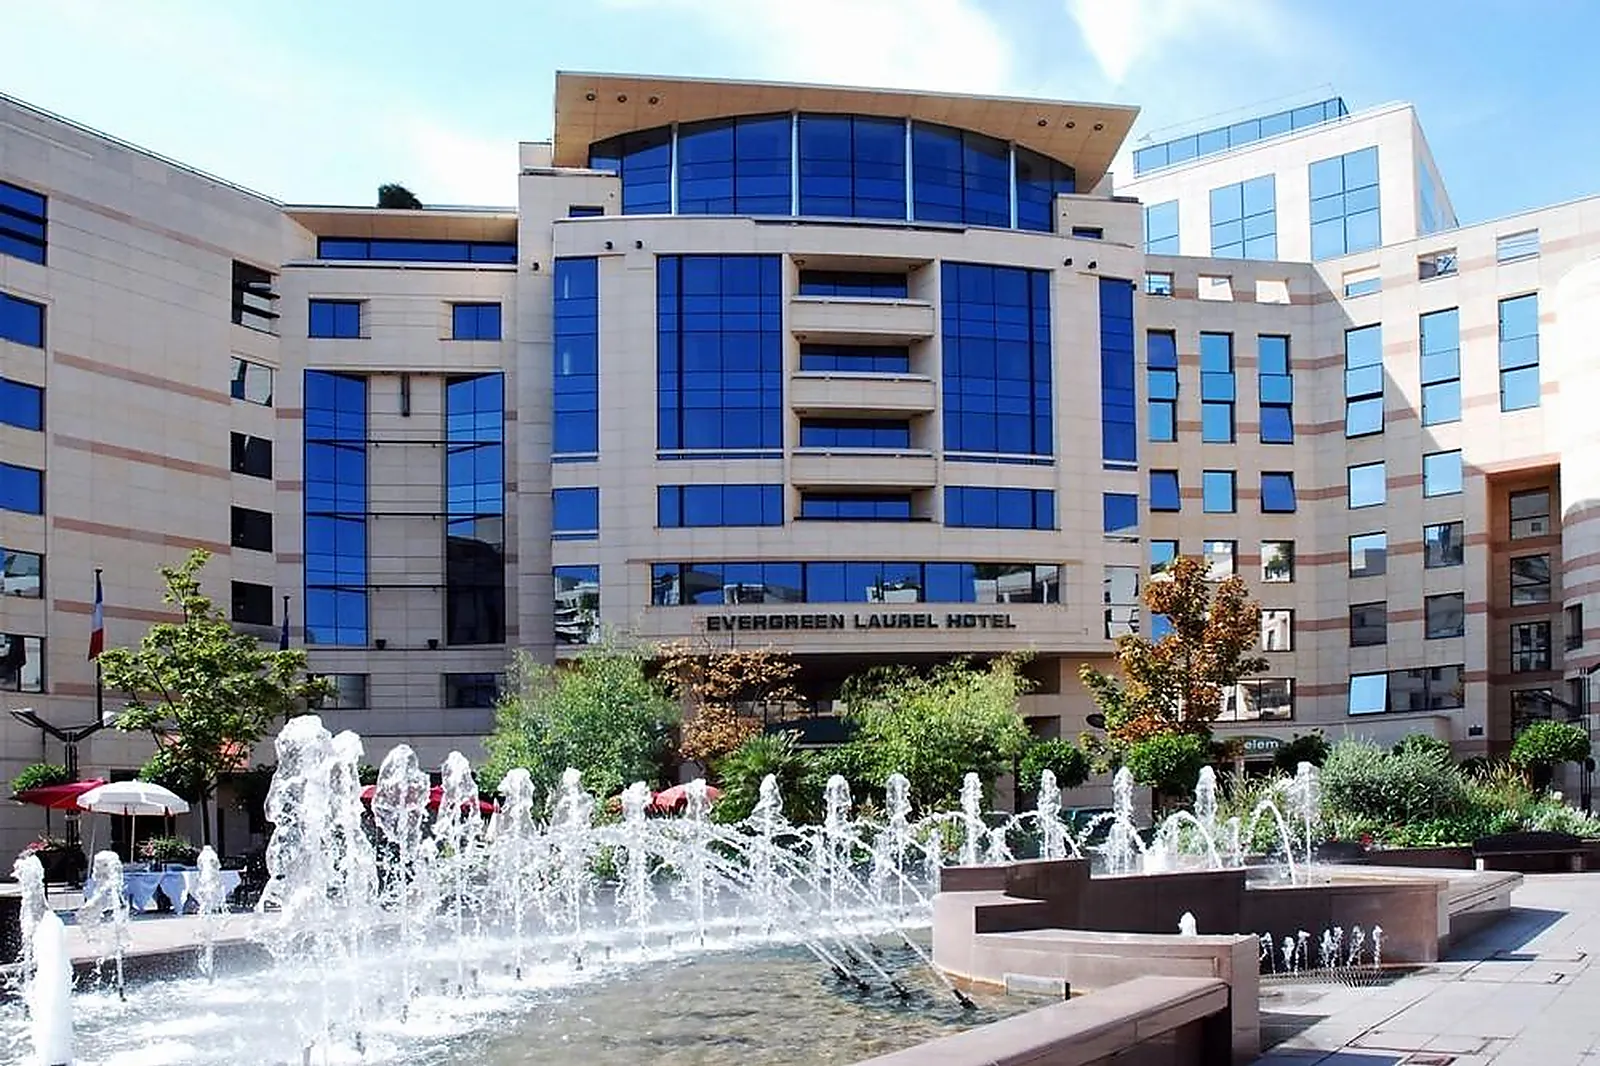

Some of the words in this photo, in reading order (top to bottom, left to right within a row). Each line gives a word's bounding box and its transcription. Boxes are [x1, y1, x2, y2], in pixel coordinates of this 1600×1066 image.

[706, 613, 845, 631] EVERGREEN
[853, 612, 939, 630] LAUREL
[946, 612, 1017, 629] HOTEL
